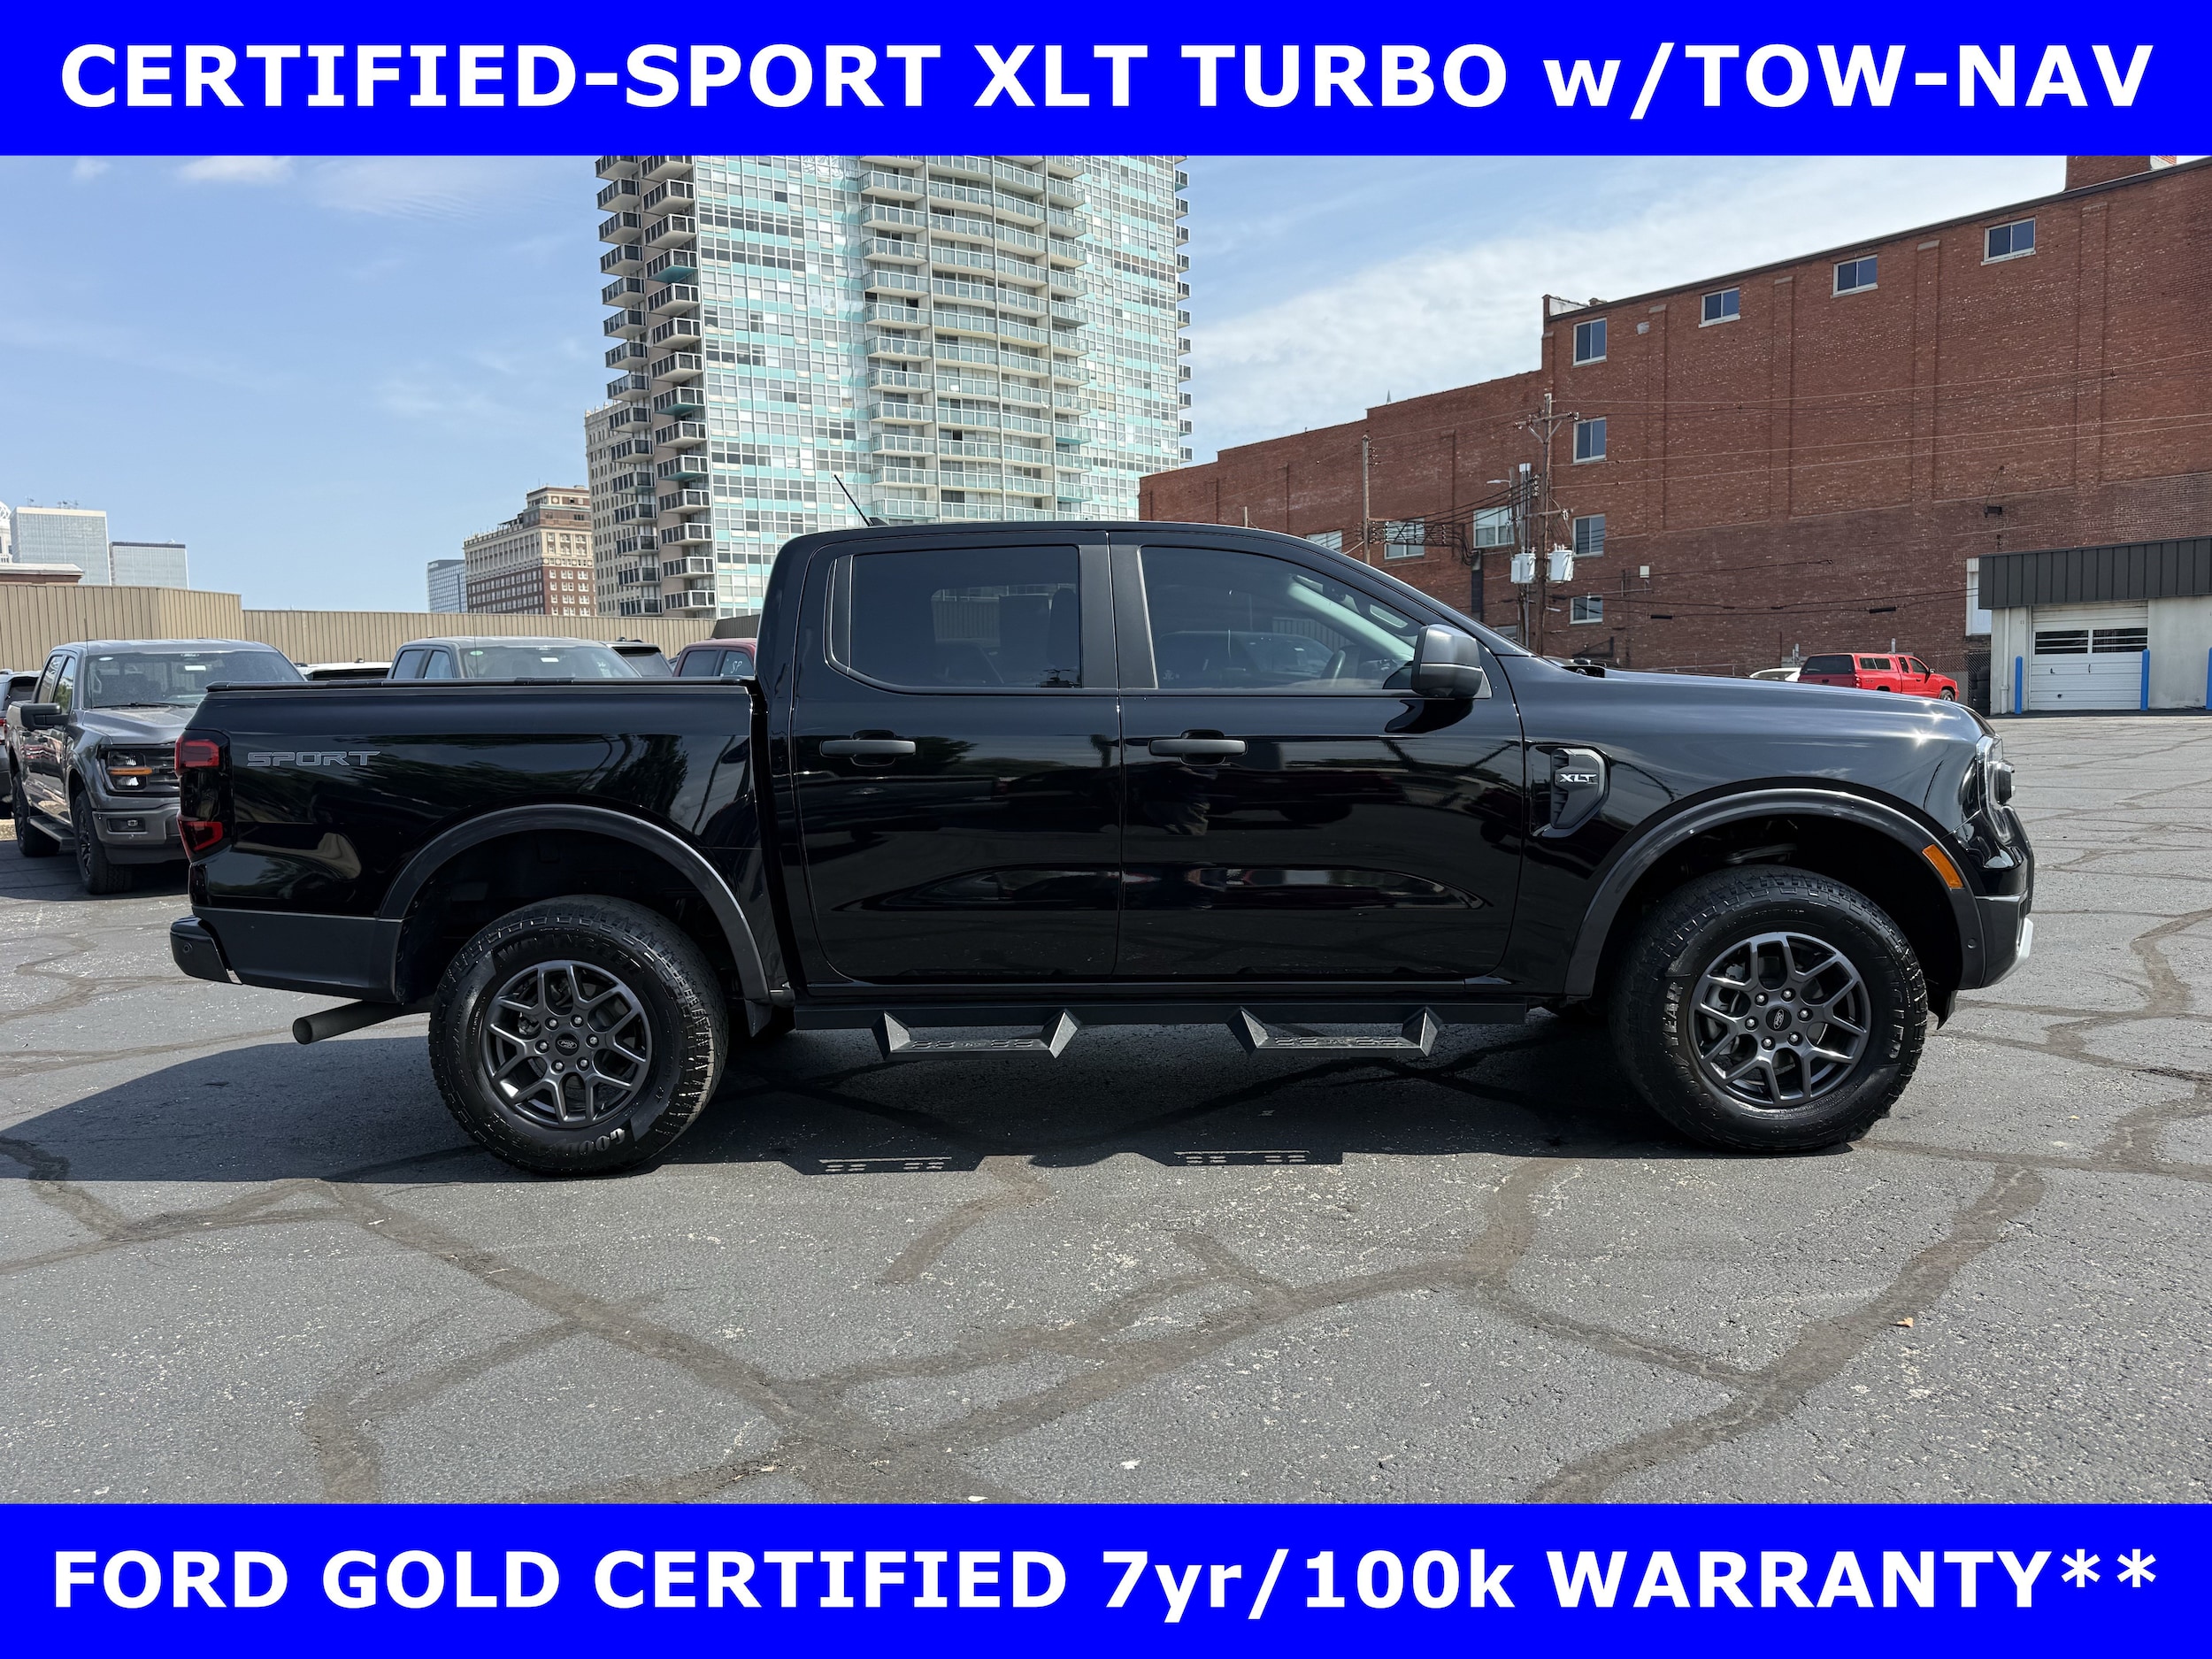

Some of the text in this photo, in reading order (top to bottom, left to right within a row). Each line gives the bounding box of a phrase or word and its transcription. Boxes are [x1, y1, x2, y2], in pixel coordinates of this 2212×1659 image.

[247, 750, 381, 767] SPORT
[1559, 773, 1598, 784] XLT
[1774, 1010, 1784, 1029] Ford
